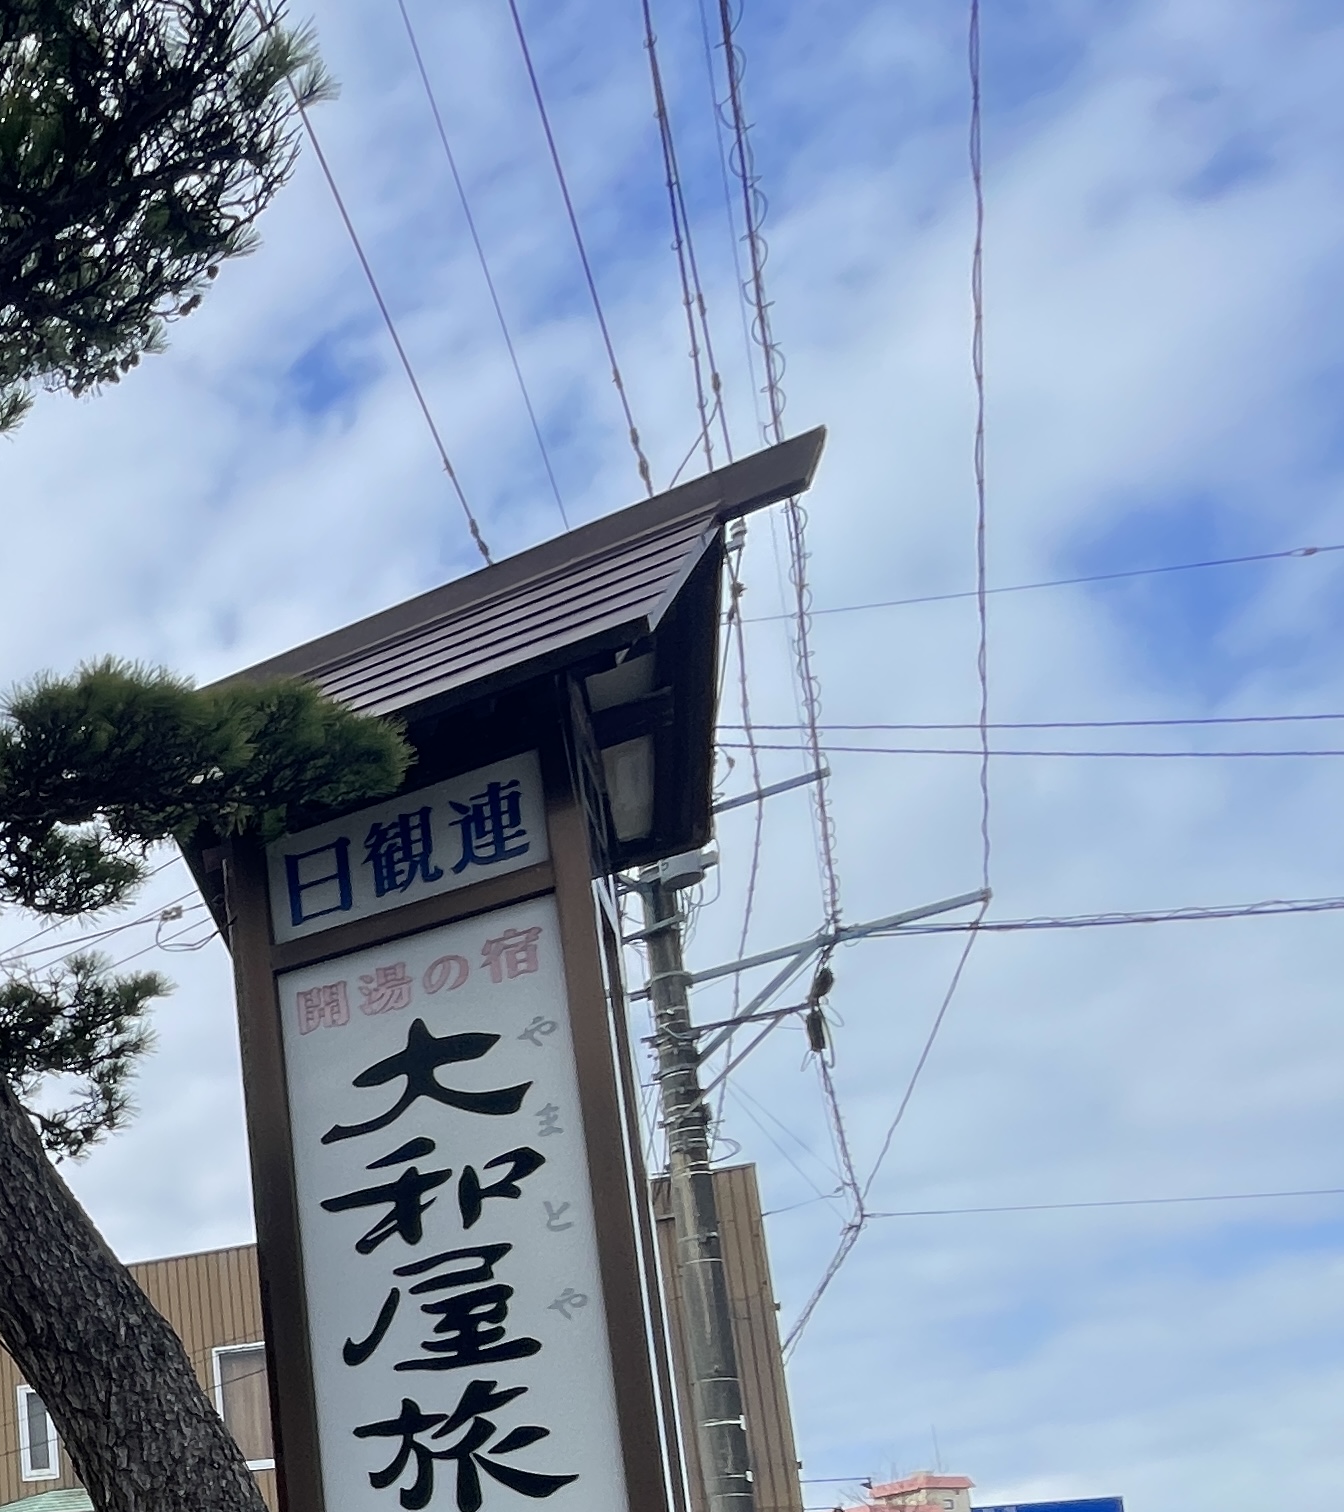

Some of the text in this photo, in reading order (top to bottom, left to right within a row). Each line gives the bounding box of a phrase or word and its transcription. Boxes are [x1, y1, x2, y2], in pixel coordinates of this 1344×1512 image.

[284, 779, 530, 927] 日観連
[296, 925, 544, 1036] 開湯の宿
[517, 1015, 587, 1320] やまとや
